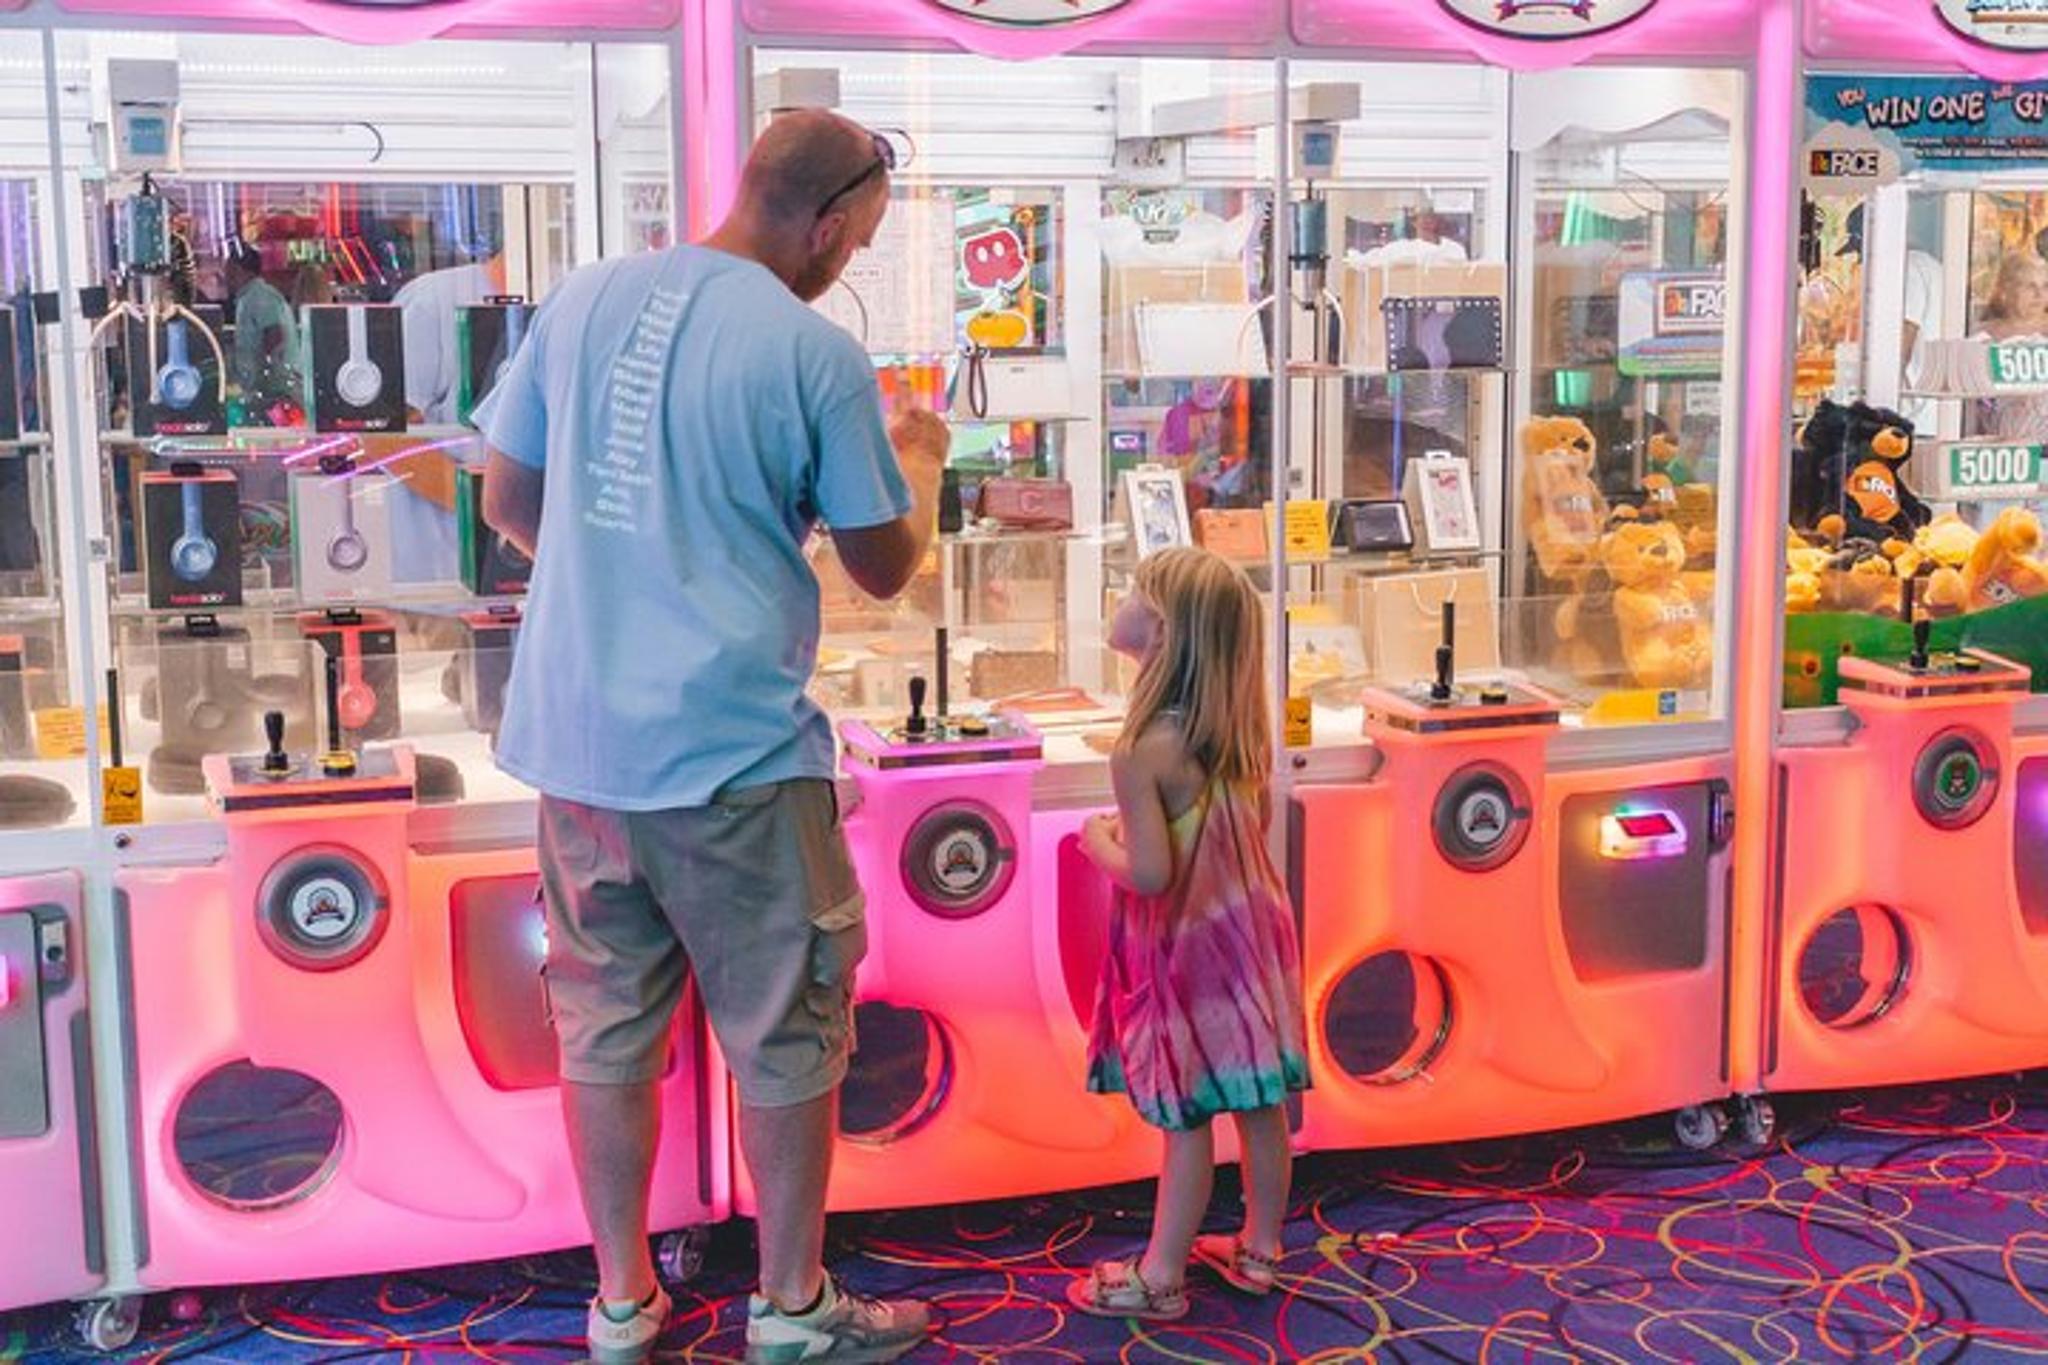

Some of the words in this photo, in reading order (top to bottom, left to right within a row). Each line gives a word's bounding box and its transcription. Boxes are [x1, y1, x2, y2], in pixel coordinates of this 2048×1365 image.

[1836, 88, 1867, 107] YOU
[1866, 97, 1921, 126] WIN
[1927, 91, 1985, 122] ONE
[1829, 151, 1878, 176] FACE
[1959, 448, 2030, 484] 5000
